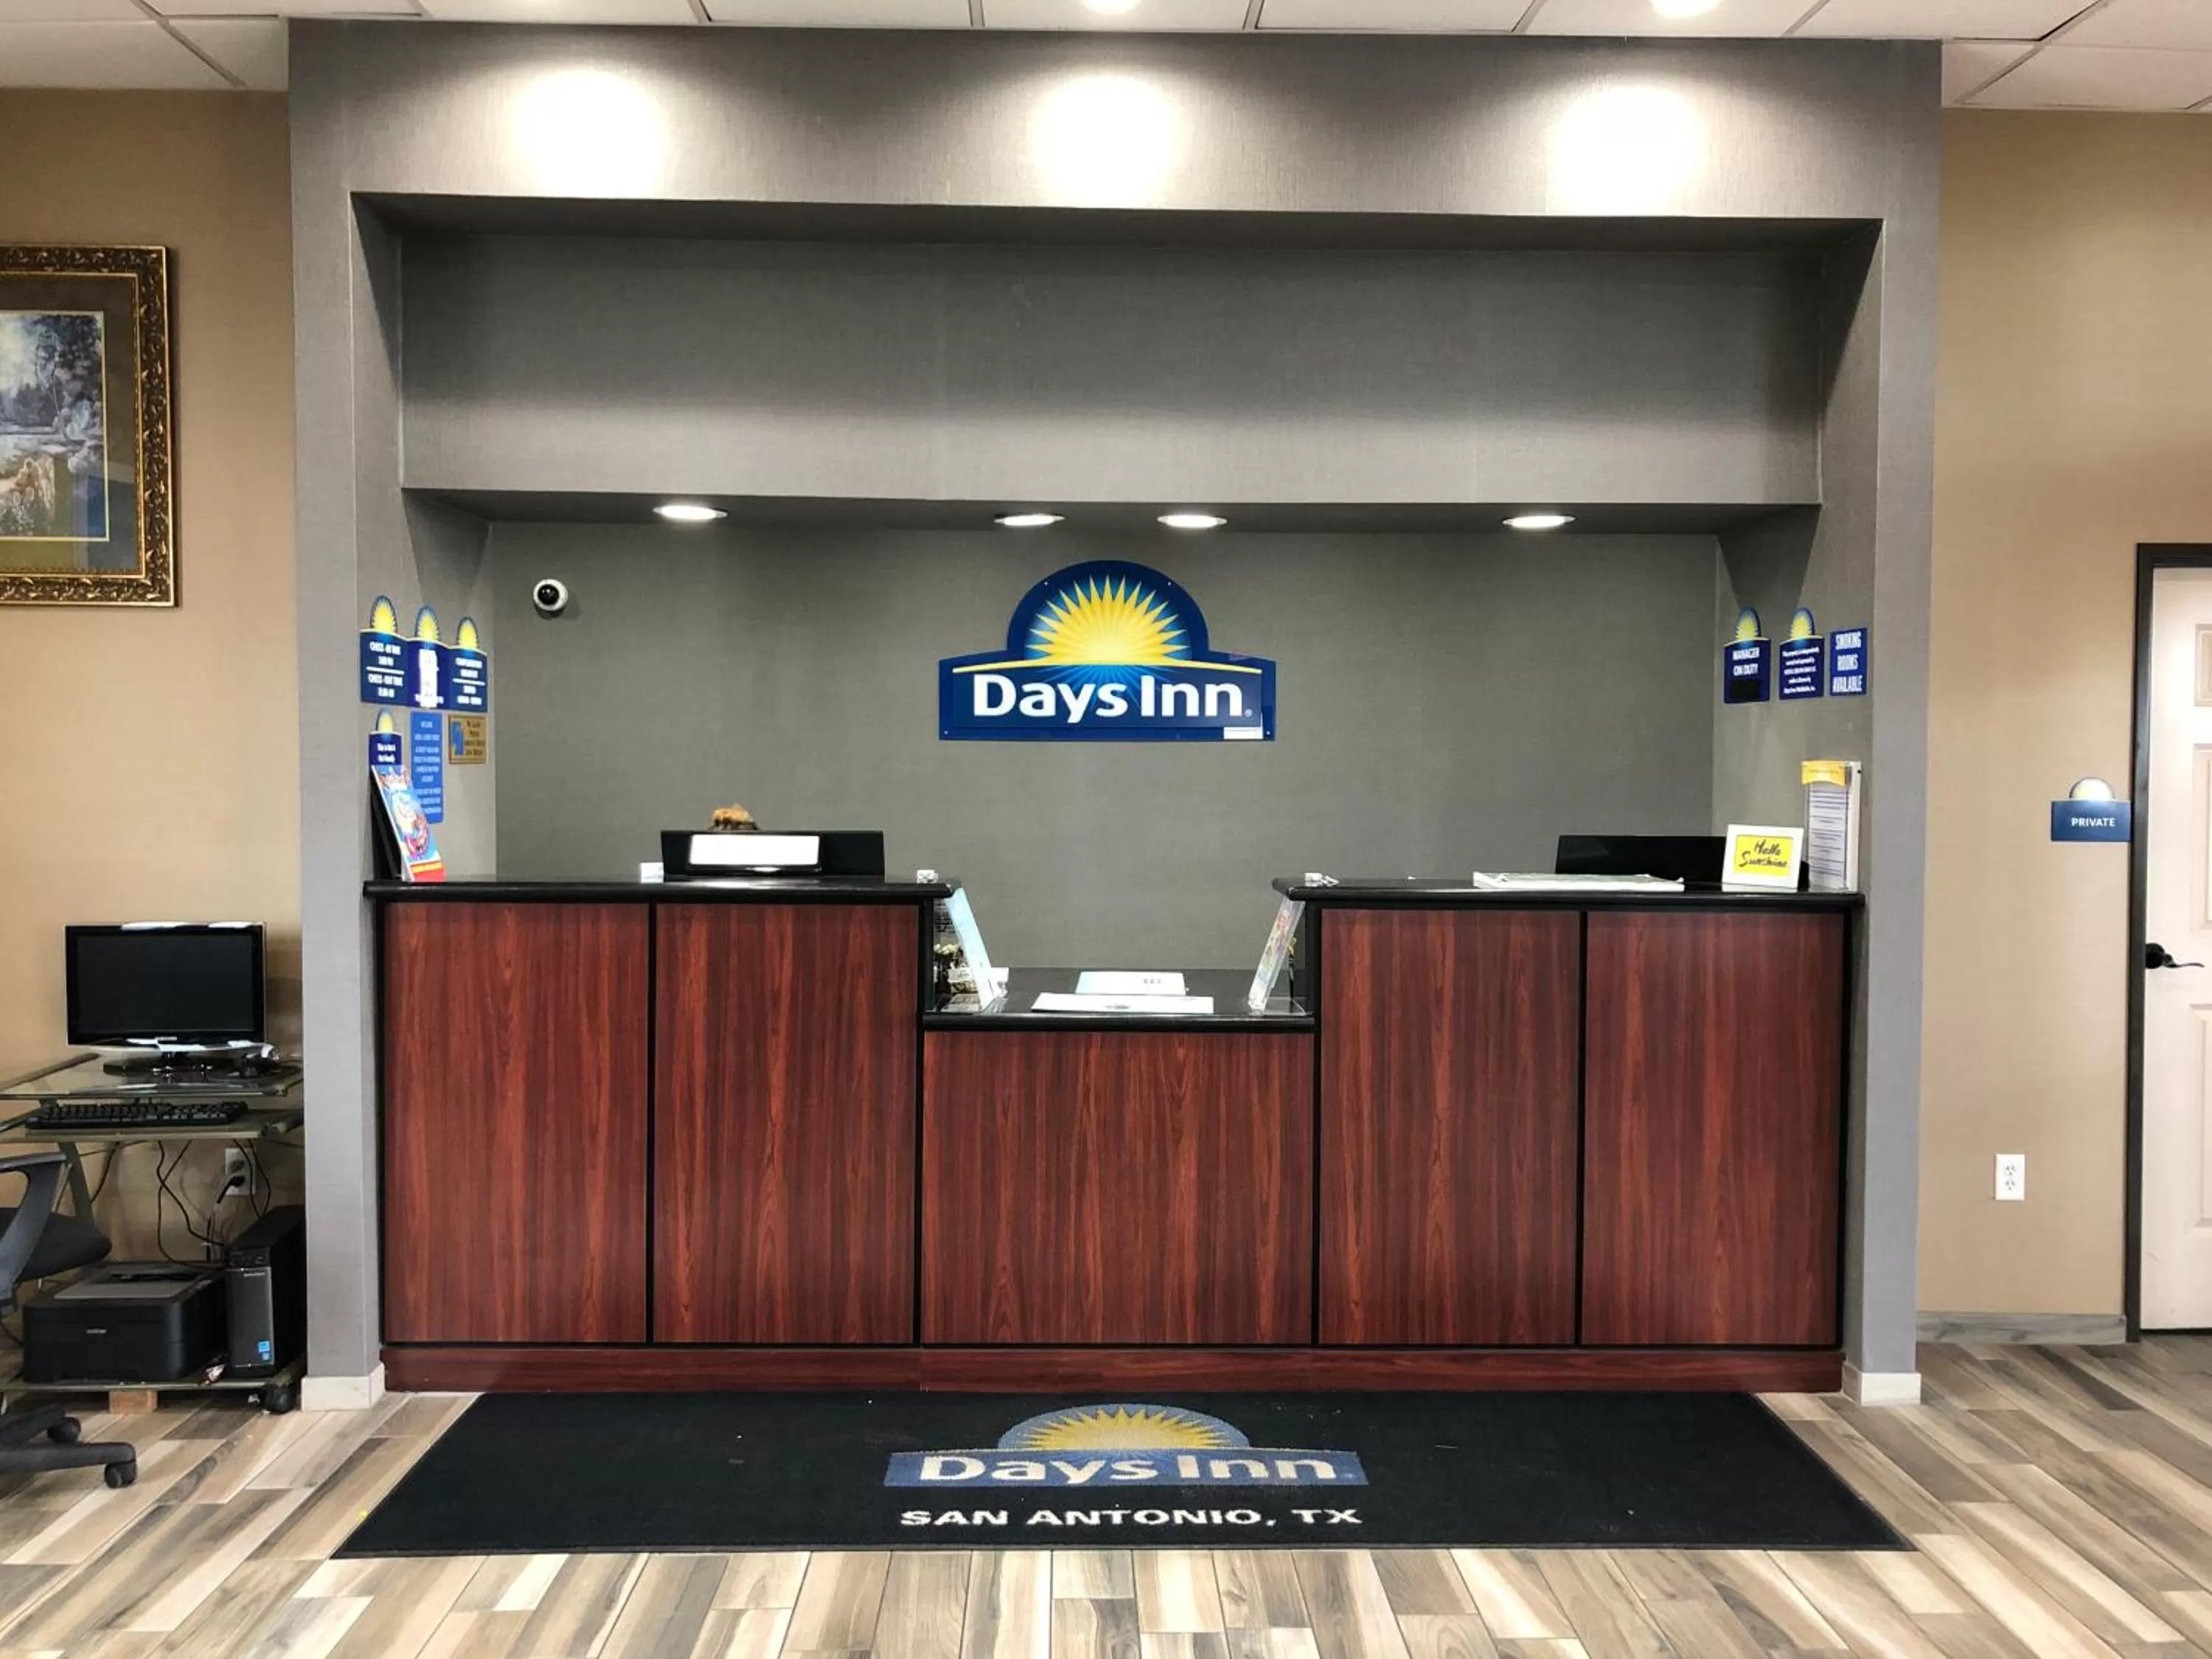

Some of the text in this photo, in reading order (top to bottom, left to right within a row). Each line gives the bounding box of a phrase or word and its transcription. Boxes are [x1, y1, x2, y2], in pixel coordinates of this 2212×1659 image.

[1835, 631, 1862, 650] SMOKING
[1732, 647, 1760, 661] MANAGER
[1837, 653, 1859, 671] ROOMS
[1733, 663, 1759, 676] ON DUTY
[1832, 675, 1863, 693] AVAILABLE
[973, 674, 1243, 723] Days Inn
[2071, 817, 2115, 827] PRIVATE
[1753, 839, 1781, 855] Hello
[918, 1455, 1336, 1485] Days Inn
[900, 1509, 1363, 1527] SAN ANTONIO, TX
